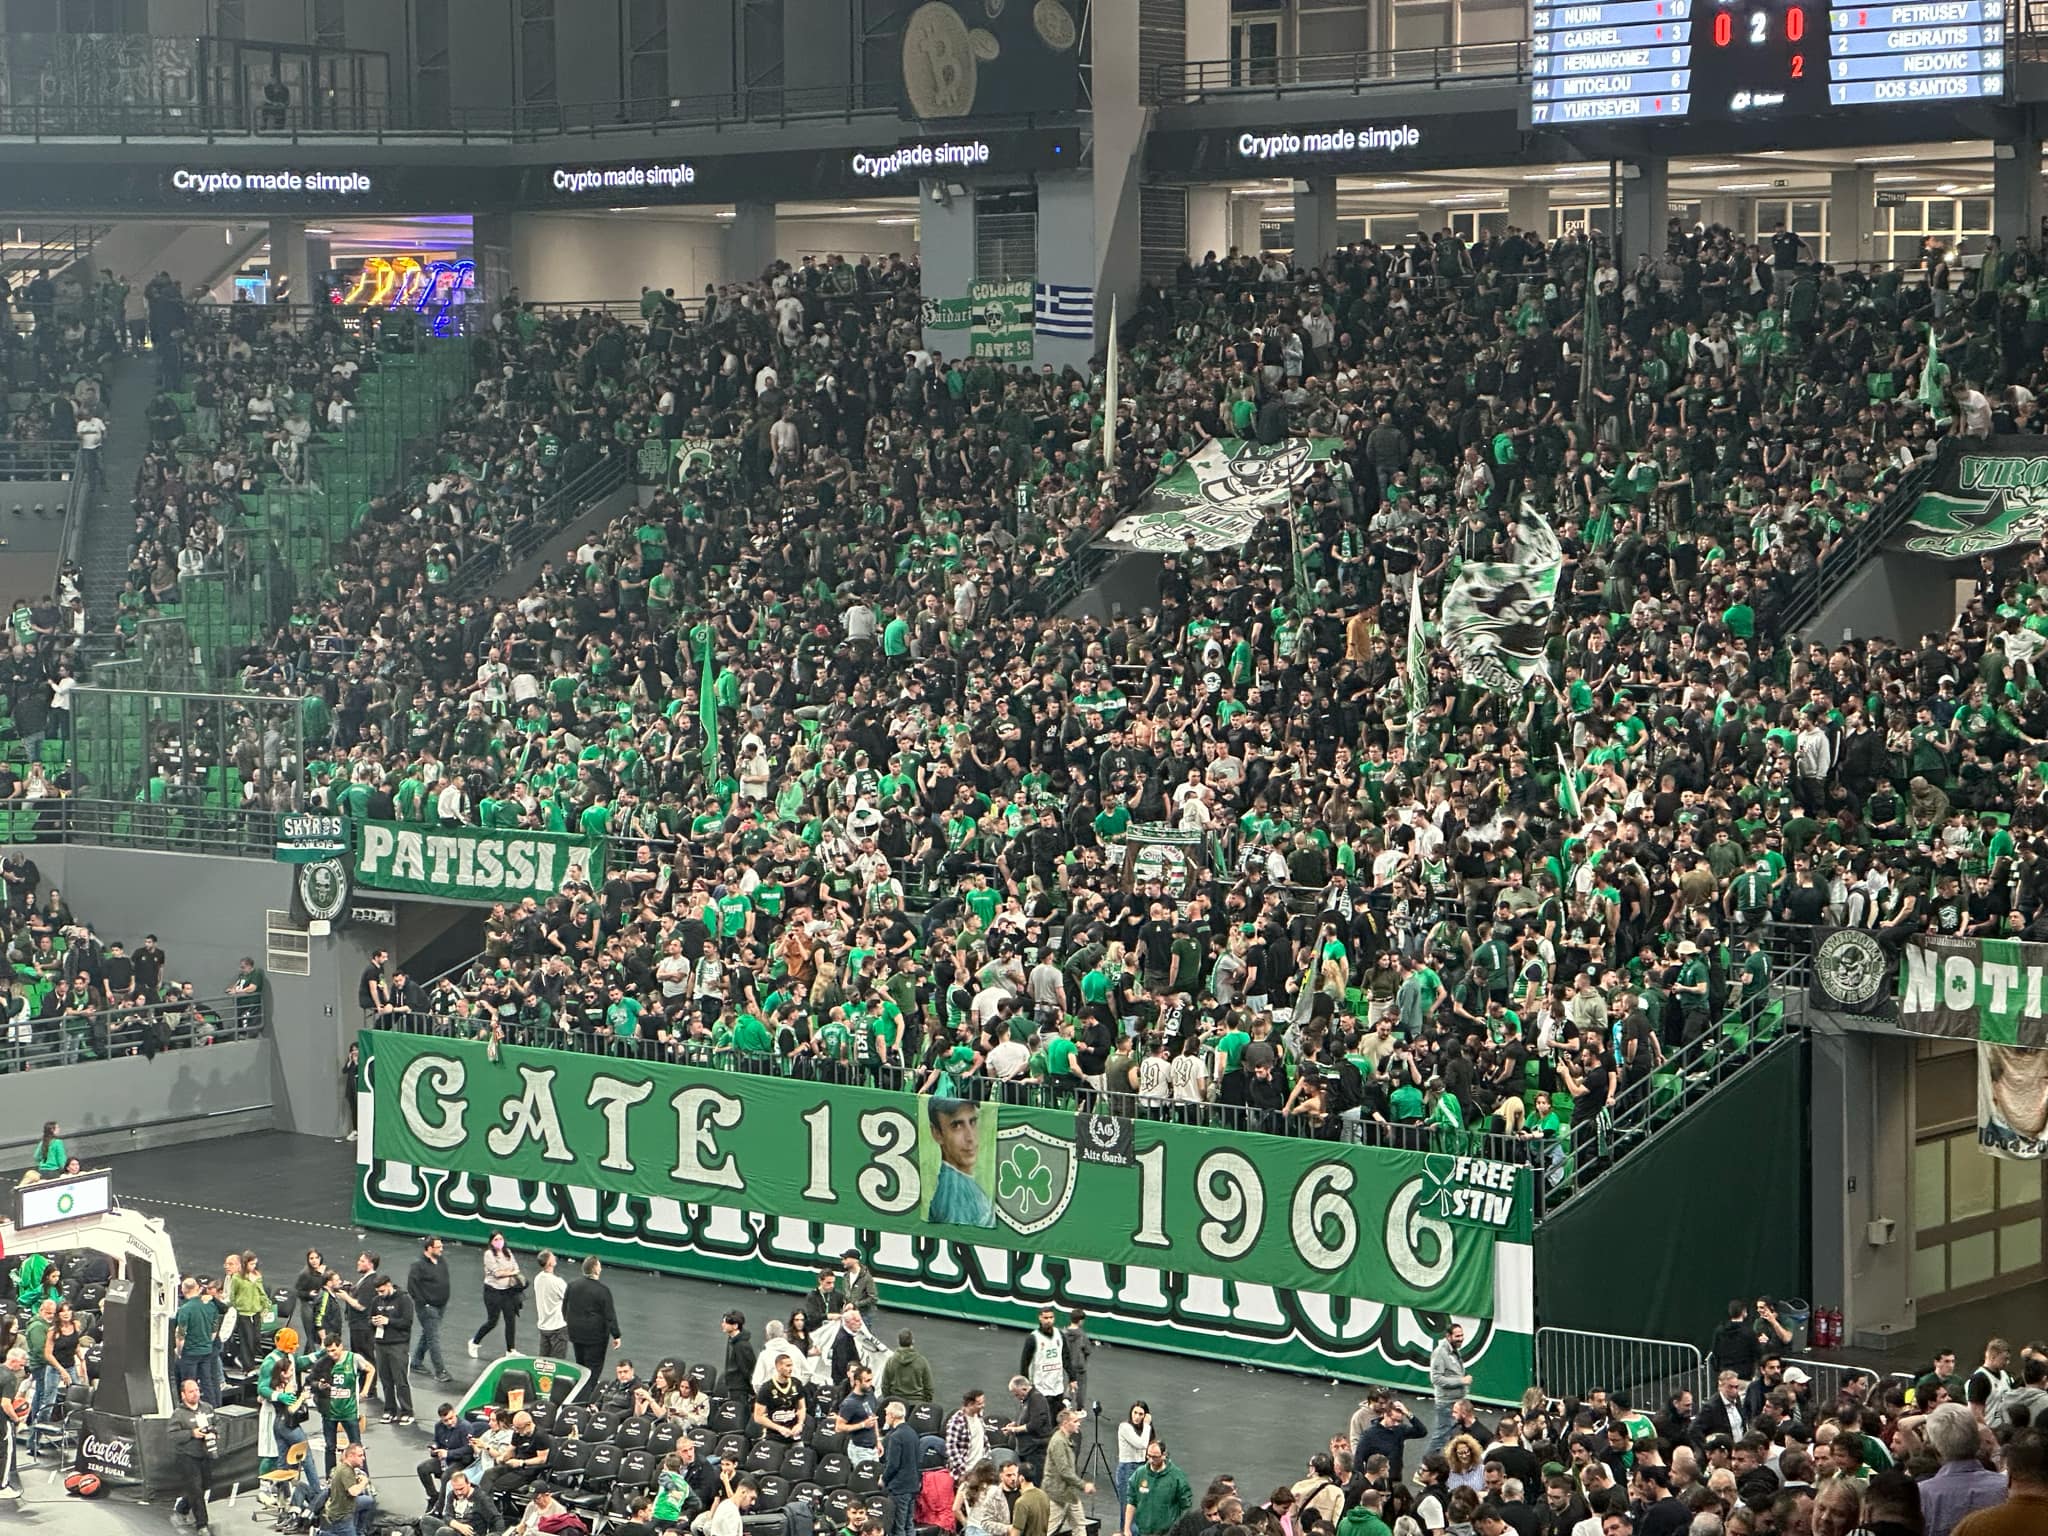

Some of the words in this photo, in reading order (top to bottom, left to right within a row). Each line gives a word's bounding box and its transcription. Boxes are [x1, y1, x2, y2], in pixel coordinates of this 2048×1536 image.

[1535, 13, 1549, 25] 25
[1564, 8, 1601, 24] NUNN
[1670, 1, 1684, 15] 10
[1892, 4, 1968, 24] PETRUSEV
[1535, 36, 1549, 49] 32
[1564, 30, 1621, 47] GABRIEL
[1672, 26, 1681, 40] 3
[1714, 12, 1731, 46] 0
[1751, 12, 1766, 42] 2
[1787, 7, 1803, 41] 0
[1839, 37, 1848, 52] 2
[1888, 29, 1968, 49] GIEDRAITIS
[1984, 28, 1999, 42] 31
[1535, 59, 1548, 73] 41
[1564, 51, 1649, 71] HERNANGOMEZ
[1791, 55, 1803, 77] 2
[1838, 62, 1848, 76] 9
[1904, 54, 1968, 72] NEDOVIC
[1564, 76, 1632, 94] MITOGLOU
[1838, 86, 1846, 100] 1
[1875, 81, 1907, 98] DOS
[1909, 78, 1968, 97] SANTOS
[1535, 106, 1548, 119] 77
[1564, 99, 1640, 117] YURTSEVEN
[1672, 97, 1680, 111] 5
[1239, 133, 1300, 158] Crypto
[1303, 129, 1355, 151] made
[1358, 125, 1420, 152] simple
[935, 141, 989, 166] simple
[173, 169, 242, 192] Crypto
[246, 171, 301, 190] made
[305, 171, 370, 194] simple
[553, 169, 601, 192] Crypto
[604, 166, 645, 186] made
[647, 163, 694, 187] simple
[1565, 220, 1585, 230] EXIT
[343, 318, 360, 329] WC
[975, 342, 1014, 357] GATE
[545, 444, 559, 456] 25
[399, 1054, 747, 1192] GATE
[802, 1101, 922, 1213] 13
[1096, 1122, 1113, 1137] AG
[1455, 1157, 1517, 1191] FREE
[1133, 1140, 1458, 1290] 1966
[127, 1234, 153, 1258] SPALDING
[1046, 1349, 1057, 1359] 25
[333, 1374, 344, 1385] 26
[82, 1434, 132, 1468] Coca-Cola
[87, 1462, 103, 1472] ZERO
[104, 1465, 125, 1477] SUGAR
